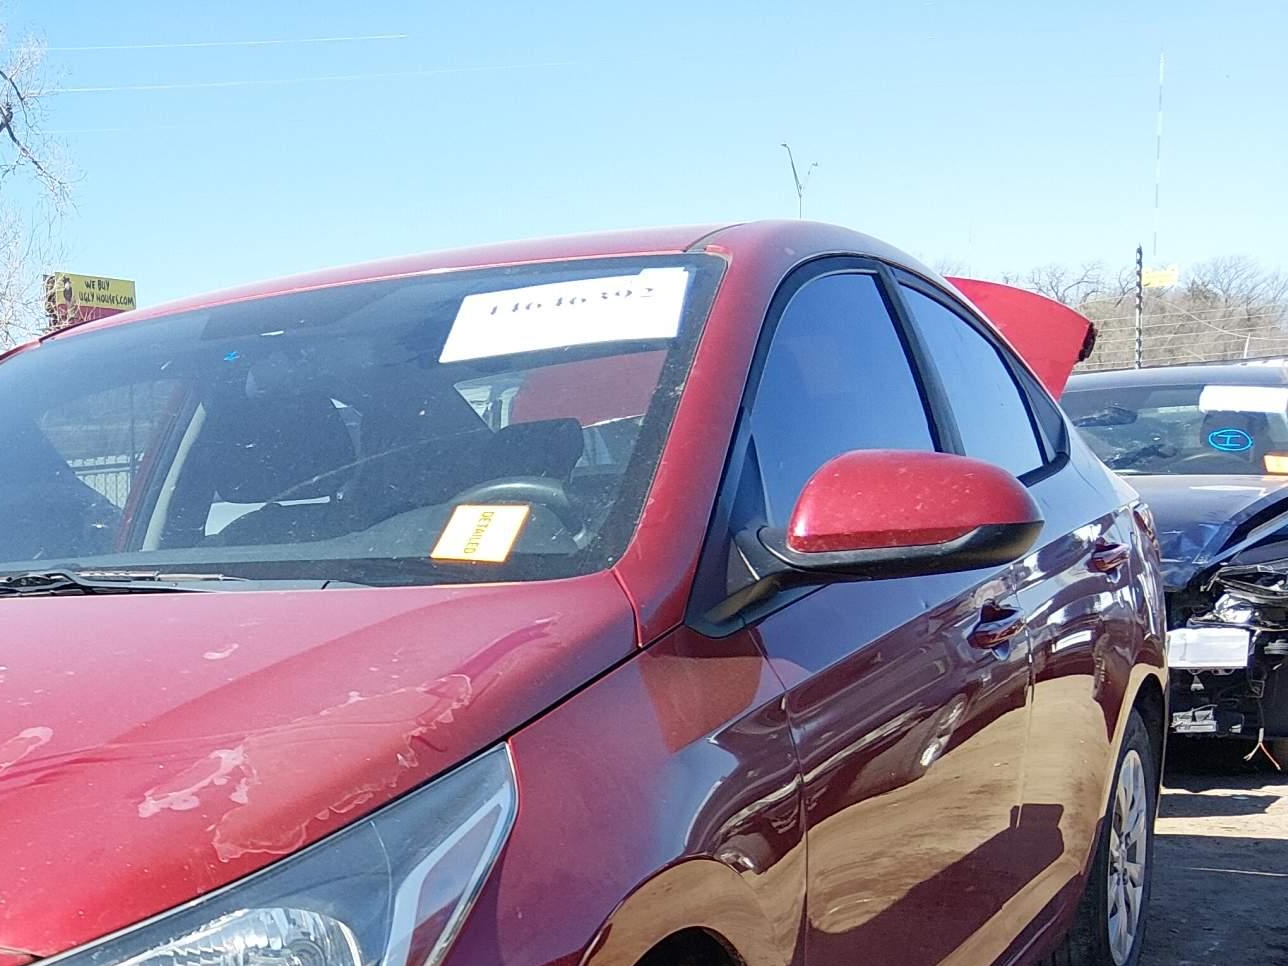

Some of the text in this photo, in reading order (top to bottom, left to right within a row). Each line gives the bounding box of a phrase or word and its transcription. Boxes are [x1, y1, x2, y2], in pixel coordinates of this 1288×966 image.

[84, 279, 110, 291] WE BUY
[78, 291, 95, 303] UGLY
